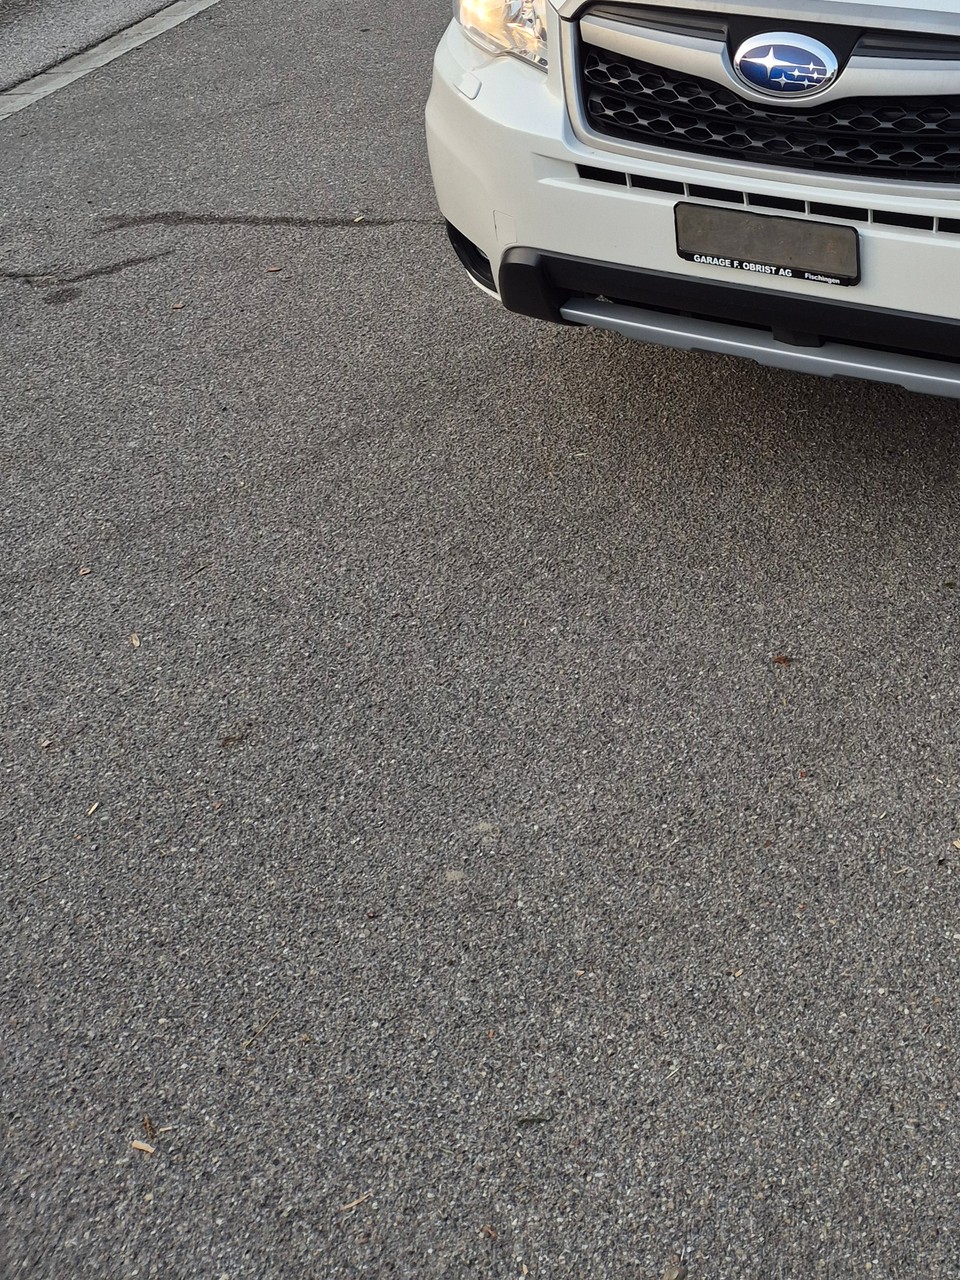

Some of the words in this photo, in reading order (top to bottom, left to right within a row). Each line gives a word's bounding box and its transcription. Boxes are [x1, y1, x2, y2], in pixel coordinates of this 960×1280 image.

[693, 254, 731, 268] GARAGE
[733, 260, 741, 269] F.
[742, 262, 777, 275] OBRIST
[778, 268, 793, 277] AG
[804, 272, 840, 284] Fischingen
